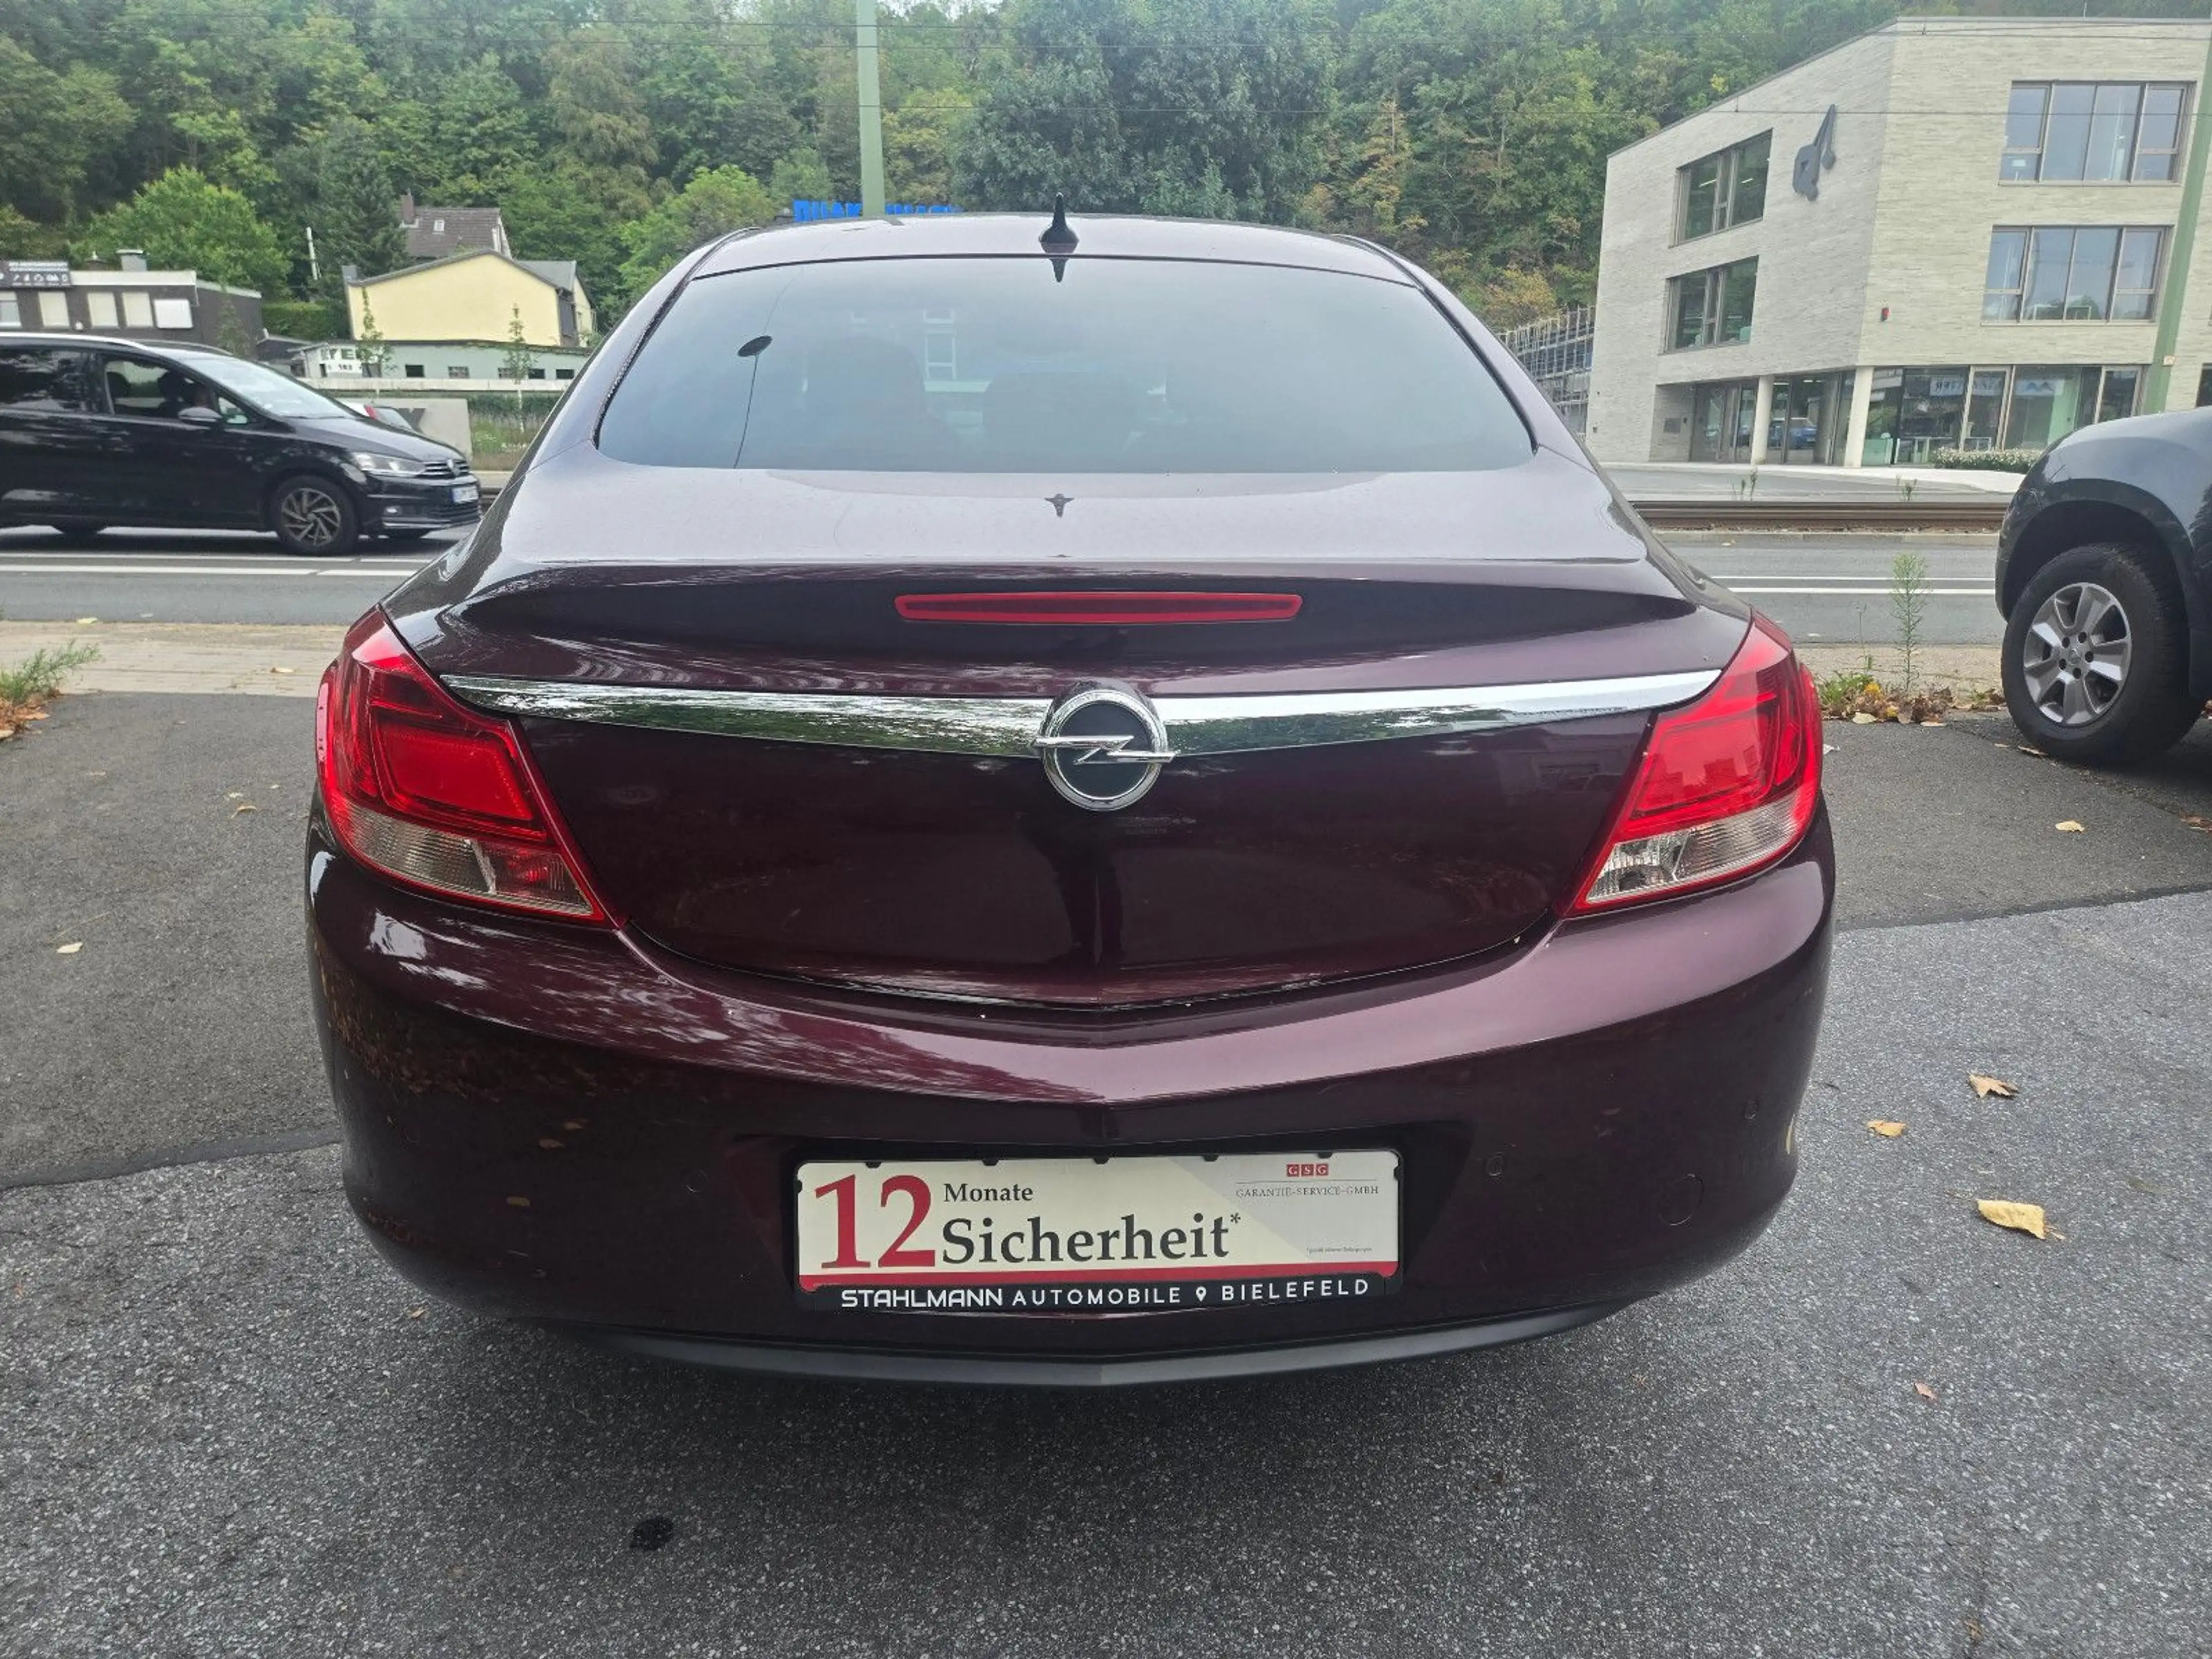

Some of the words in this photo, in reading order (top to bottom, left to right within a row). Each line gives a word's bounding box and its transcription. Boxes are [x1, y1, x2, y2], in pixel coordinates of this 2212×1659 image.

[1287, 1164, 1329, 1177] GSG
[943, 1183, 1034, 1202] Monate
[815, 1173, 936, 1269] 12
[841, 1288, 1003, 1308] STAHLMANN
[1012, 1286, 1181, 1306] AUTOMOBILE
[1221, 1279, 1369, 1301] BIELEFELD
